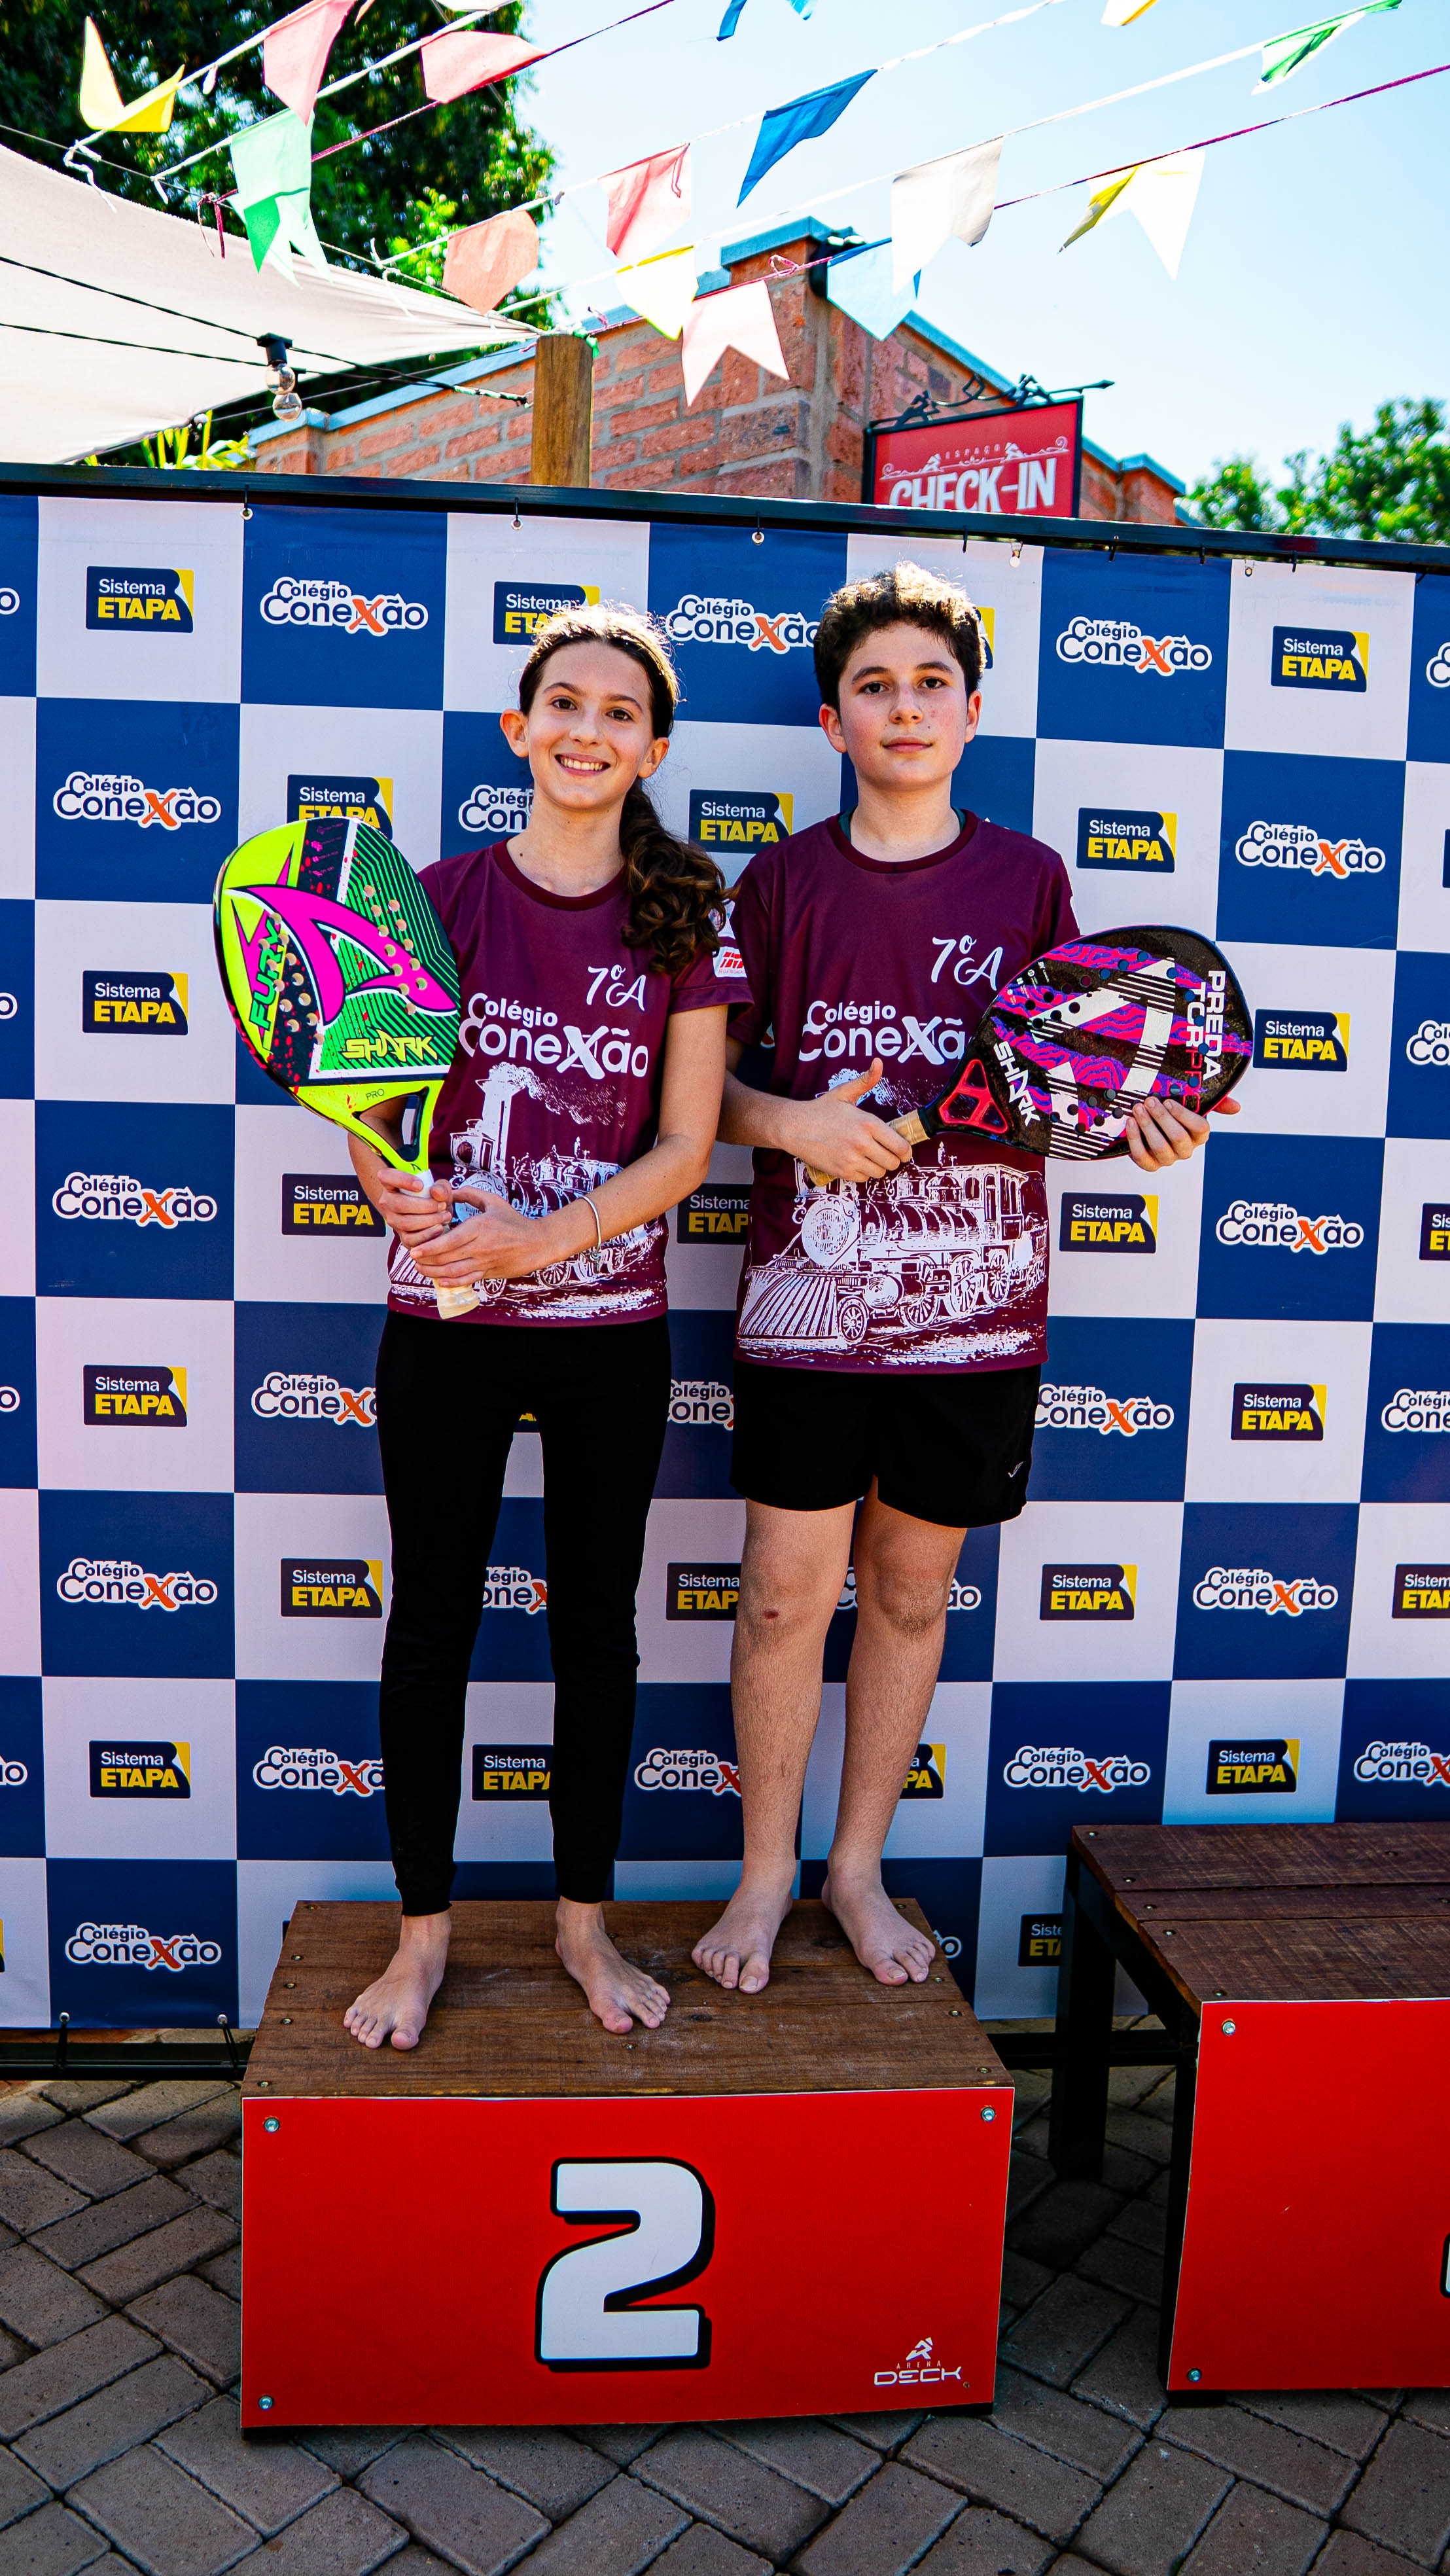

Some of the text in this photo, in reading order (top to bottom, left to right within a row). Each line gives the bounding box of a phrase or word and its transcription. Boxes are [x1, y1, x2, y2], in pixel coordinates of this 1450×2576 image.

[889, 457, 1057, 512] CHECK-IN
[97, 580, 165, 597] Sistema
[276, 580, 347, 604] Colégio
[97, 598, 181, 622] ETAPA
[505, 595, 572, 613] Sistema
[681, 598, 751, 622] Colégio
[504, 613, 550, 638] ETA
[1072, 620, 1139, 645] Colégio
[1283, 640, 1344, 658] Sistema
[1282, 657, 1358, 683] ETAPA
[70, 774, 141, 798] Colégio
[298, 787, 365, 804] Sistema
[700, 802, 766, 819] Sistema
[699, 819, 781, 844] ETAPA
[1088, 820, 1151, 838] Sistema
[1251, 823, 1316, 848] Colégio
[1087, 837, 1165, 862] ETAPA
[94, 982, 160, 998] Sistema
[94, 999, 176, 1023] ETAPA
[468, 992, 558, 1027] Colégio
[806, 1001, 896, 1027] Colégio
[1203, 970, 1226, 1081] PREDA
[1265, 1020, 1325, 1037] Sistema
[342, 1028, 438, 1063] SHARK
[1263, 1037, 1338, 1061] ETAPA
[993, 1041, 1041, 1127] SHARK
[366, 1088, 385, 1101] PRO
[69, 1174, 138, 1197] Colégio
[294, 1185, 359, 1202] Sistema
[293, 1202, 375, 1226] ETAPA
[1071, 1204, 1133, 1220] Sistema
[1231, 1202, 1295, 1225] Colégio
[688, 1211, 749, 1234] ETAP
[1069, 1221, 1146, 1243] ETAPA
[95, 1376, 160, 1392] Sistema
[268, 1374, 336, 1395] Colégio
[95, 1393, 175, 1416] ETAPA
[1038, 1386, 1103, 1407] Colégio
[1243, 1394, 1302, 1409] Sistema
[1396, 1391, 1450, 1410] Colégi
[1241, 1411, 1315, 1431] ETAPA
[72, 1561, 140, 1583] Colégio
[292, 1570, 356, 1585] Sistema
[678, 1574, 741, 1588] Sistema
[1052, 1575, 1112, 1589] Sistema
[1209, 1570, 1271, 1589] Colégio
[1404, 1574, 1450, 1588] Sistem
[292, 1586, 371, 1607] ETAPA
[677, 1590, 739, 1611] ETAP
[1050, 1592, 1125, 1611] ETAPA
[100, 1751, 164, 1766] Sistema
[268, 1748, 335, 1768] Colégio
[649, 1750, 715, 1769] Colégio
[1019, 1747, 1082, 1767] Colégio
[1218, 1749, 1275, 1763] Sistema
[1367, 1740, 1426, 1761] Colégio
[484, 1755, 546, 1769] Sistema
[100, 1768, 179, 1788] ETAPA
[1216, 1764, 1288, 1784] ETAPA
[80, 1923, 147, 1942] Colégio
[1031, 1922, 1063, 1935] Siste
[537, 2158, 712, 2368] 2
[896, 2360, 941, 2369] ARENA
[874, 2366, 962, 2386] DECK
